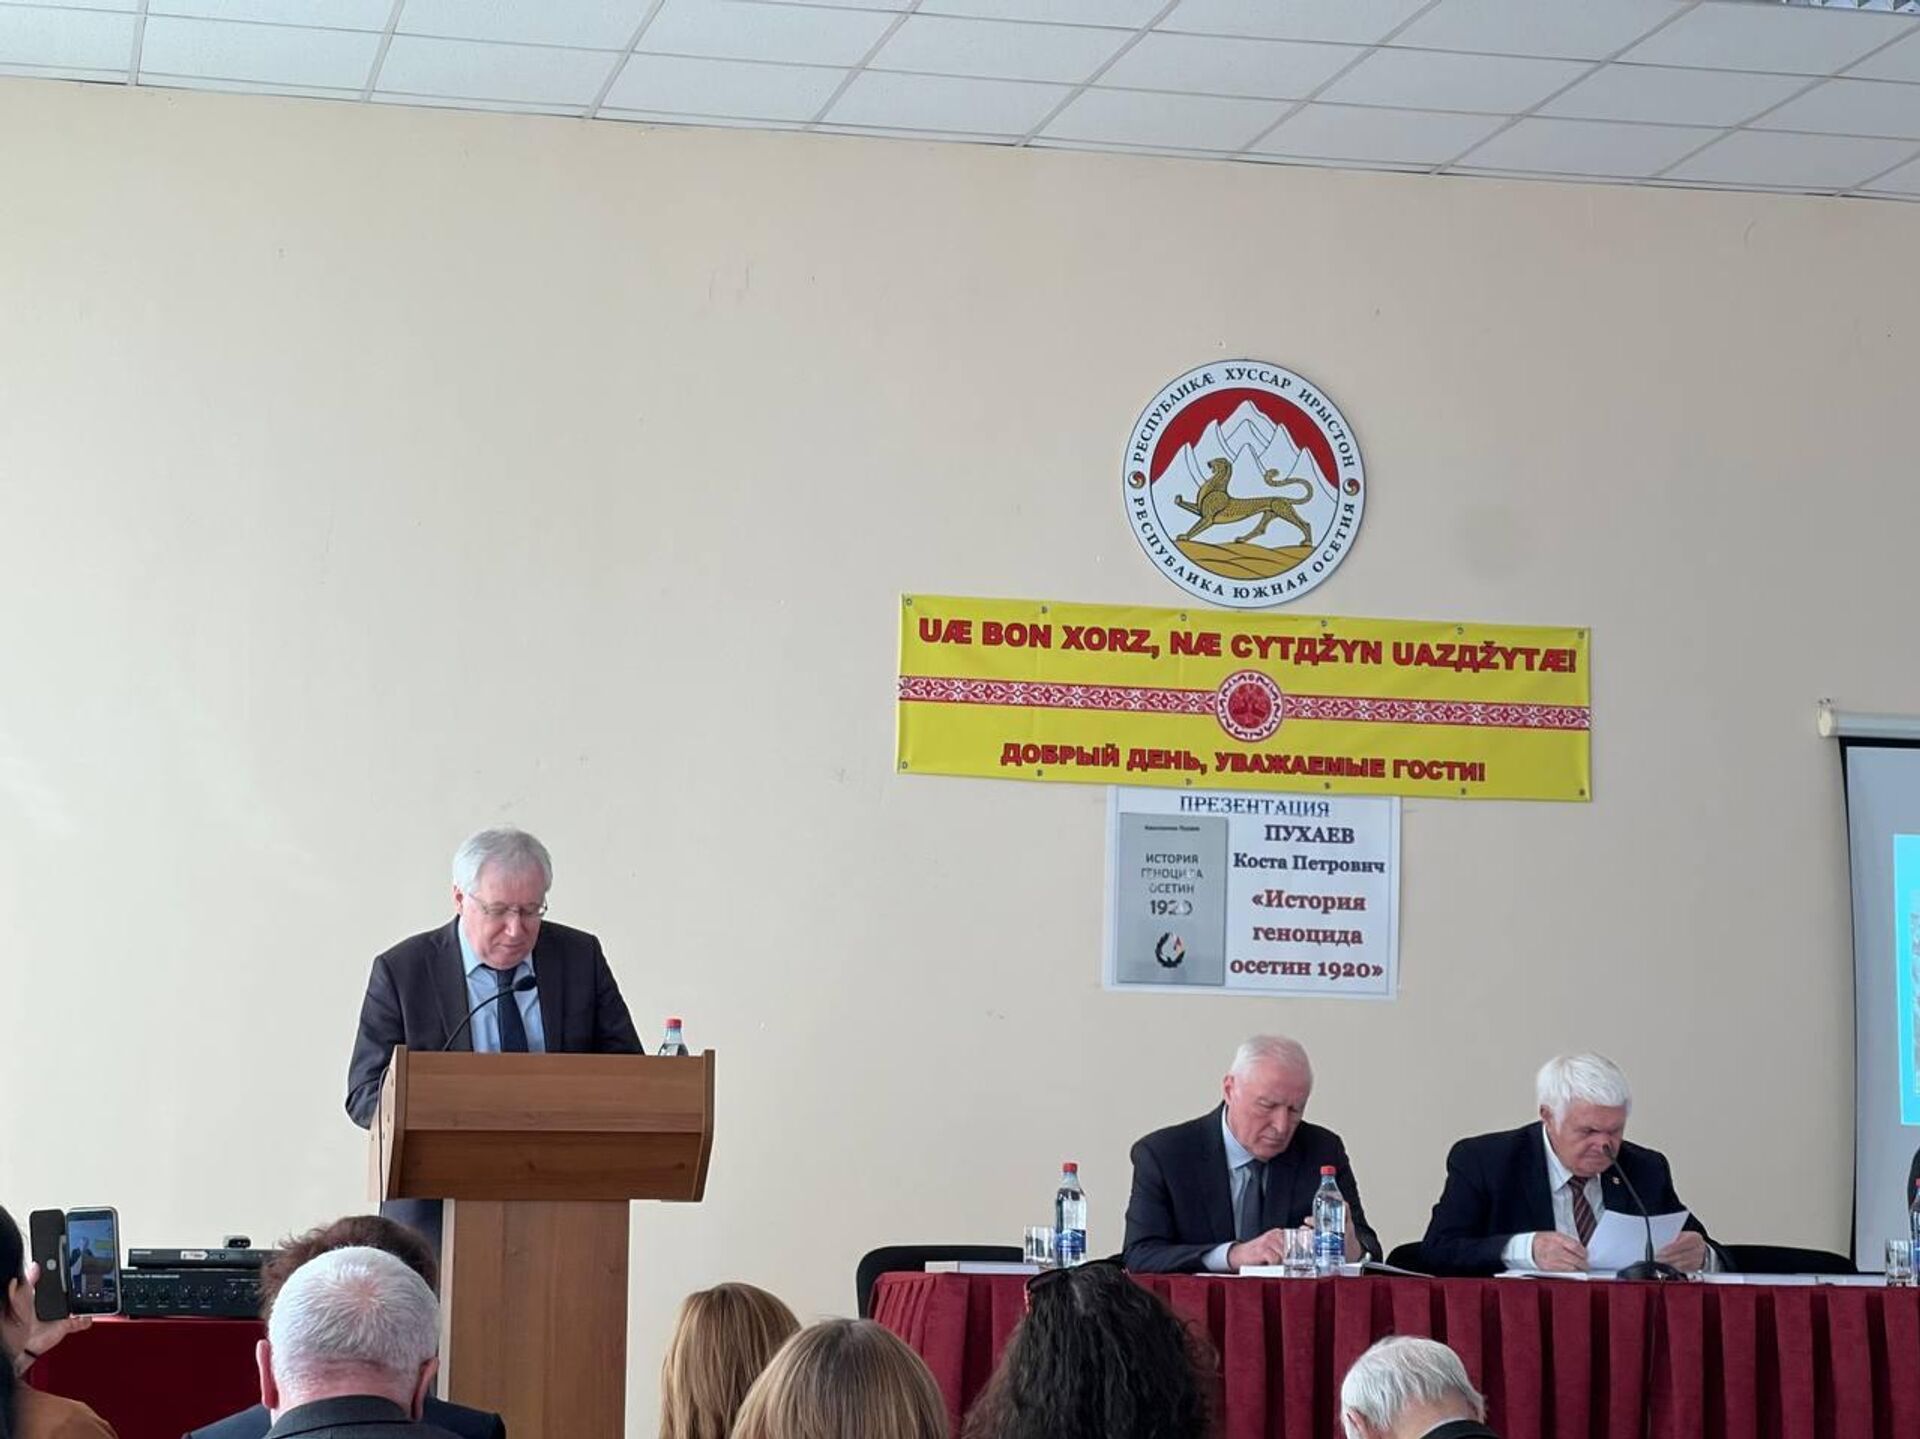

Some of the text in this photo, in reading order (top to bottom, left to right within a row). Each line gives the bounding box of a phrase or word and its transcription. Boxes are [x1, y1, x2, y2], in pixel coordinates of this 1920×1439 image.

[1134, 367, 1355, 468] РЕСПУБЛИКÆ ХУССАР ИРЫСТОН
[1133, 496, 1356, 600] РЕСПУБЛИКА ЮЖНАЯ ОСЕТИЯ
[982, 621, 1052, 650] BON
[1061, 625, 1161, 660] XORZ,
[1000, 742, 1486, 783] ДОБРЫЙ ДЕНЬ, УВАЖАЕМЫЕ ГОСТИ!
[1180, 795, 1330, 819] ПРЕЗЕНТАЦИЯ
[1265, 825, 1355, 845] ПУХАЕВ
[1145, 853, 1199, 864] ИСТОРИЯ
[1233, 852, 1385, 876] Коста Петрович
[1252, 890, 1366, 914] «История
[1253, 926, 1363, 945] геноцида
[1230, 959, 1384, 980] осетин 1920»
